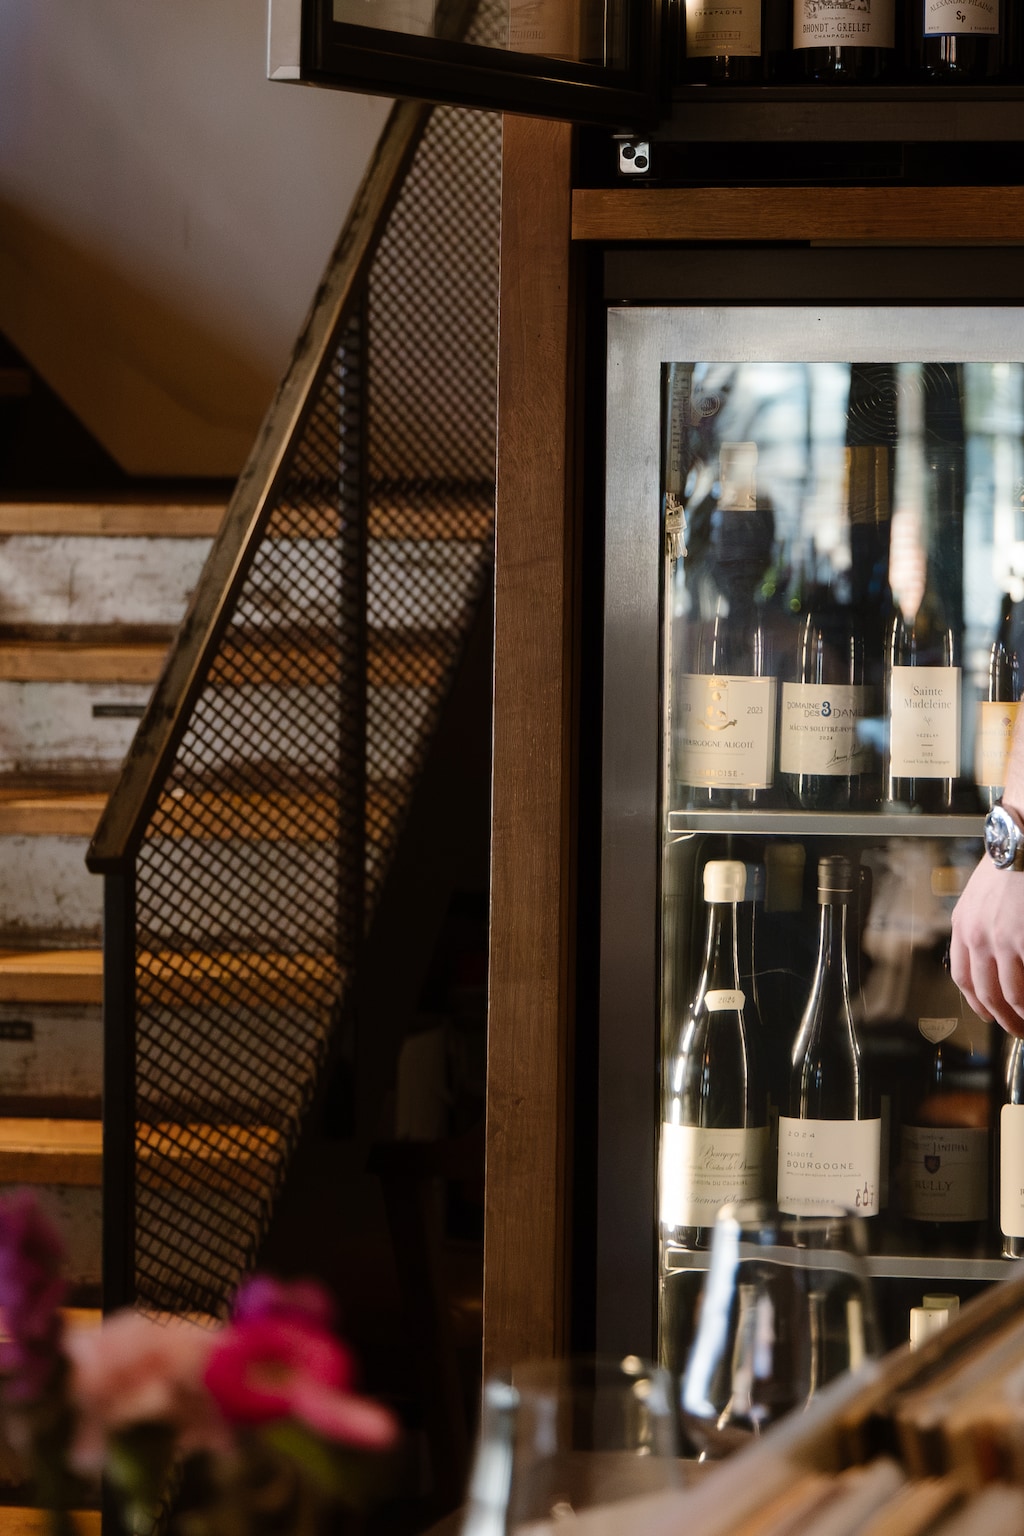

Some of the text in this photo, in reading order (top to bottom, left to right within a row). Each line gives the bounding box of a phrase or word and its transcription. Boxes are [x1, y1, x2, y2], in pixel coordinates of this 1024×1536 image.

[956, 10, 967, 23] Sp
[803, 24, 829, 33] DHONDT
[837, 23, 871, 33] GRELLET
[913, 685, 943, 696] Sainte
[787, 701, 820, 711] DOMAINE
[904, 699, 952, 709] Madeleine
[804, 710, 820, 718] DES
[821, 701, 832, 717] 3
[787, 1160, 854, 1170] BOURGOGNE
[914, 1180, 953, 1192] RULLY
